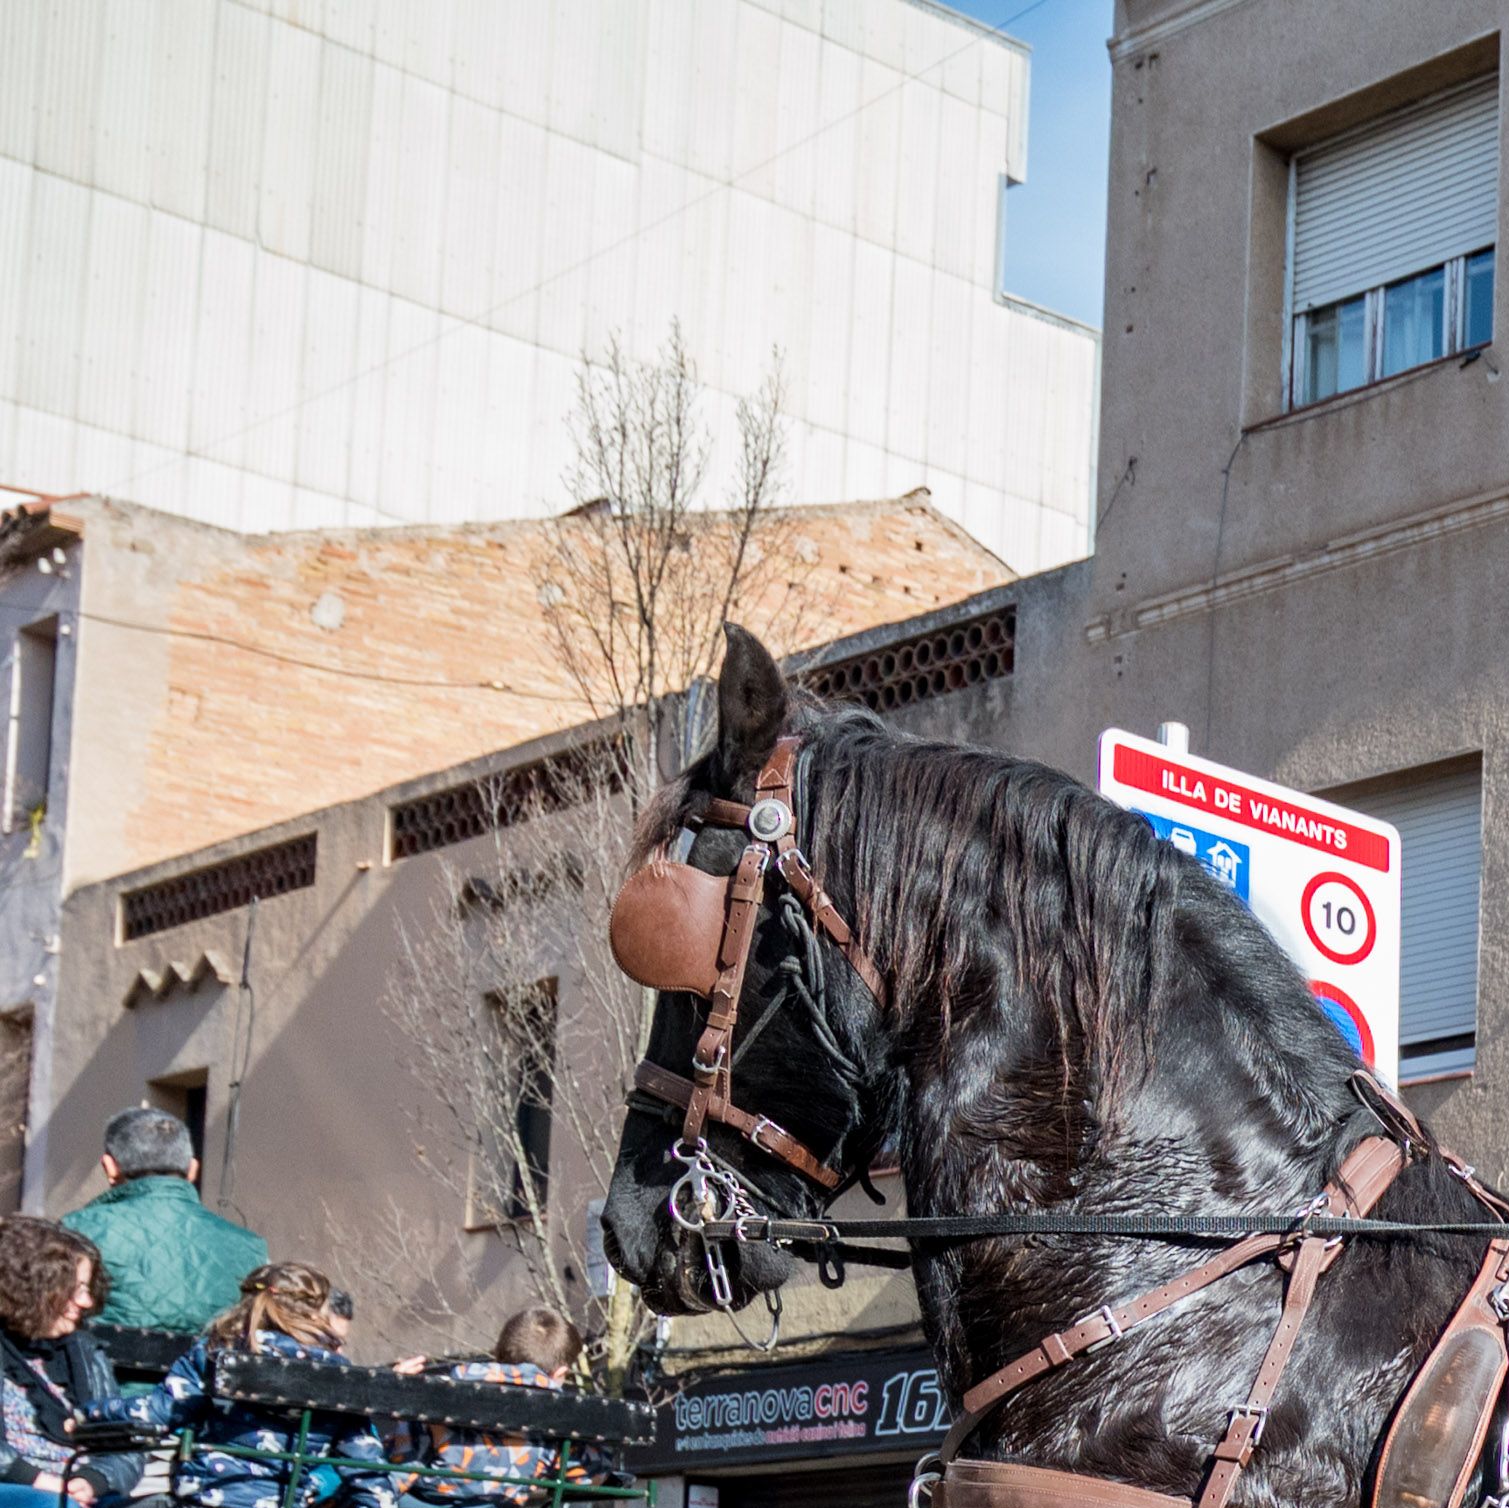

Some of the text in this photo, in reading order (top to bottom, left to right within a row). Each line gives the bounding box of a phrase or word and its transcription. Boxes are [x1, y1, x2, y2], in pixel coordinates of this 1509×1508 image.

[1162, 769, 1347, 850] ILLA DE VIANANTS
[1321, 901, 1356, 936] 10
